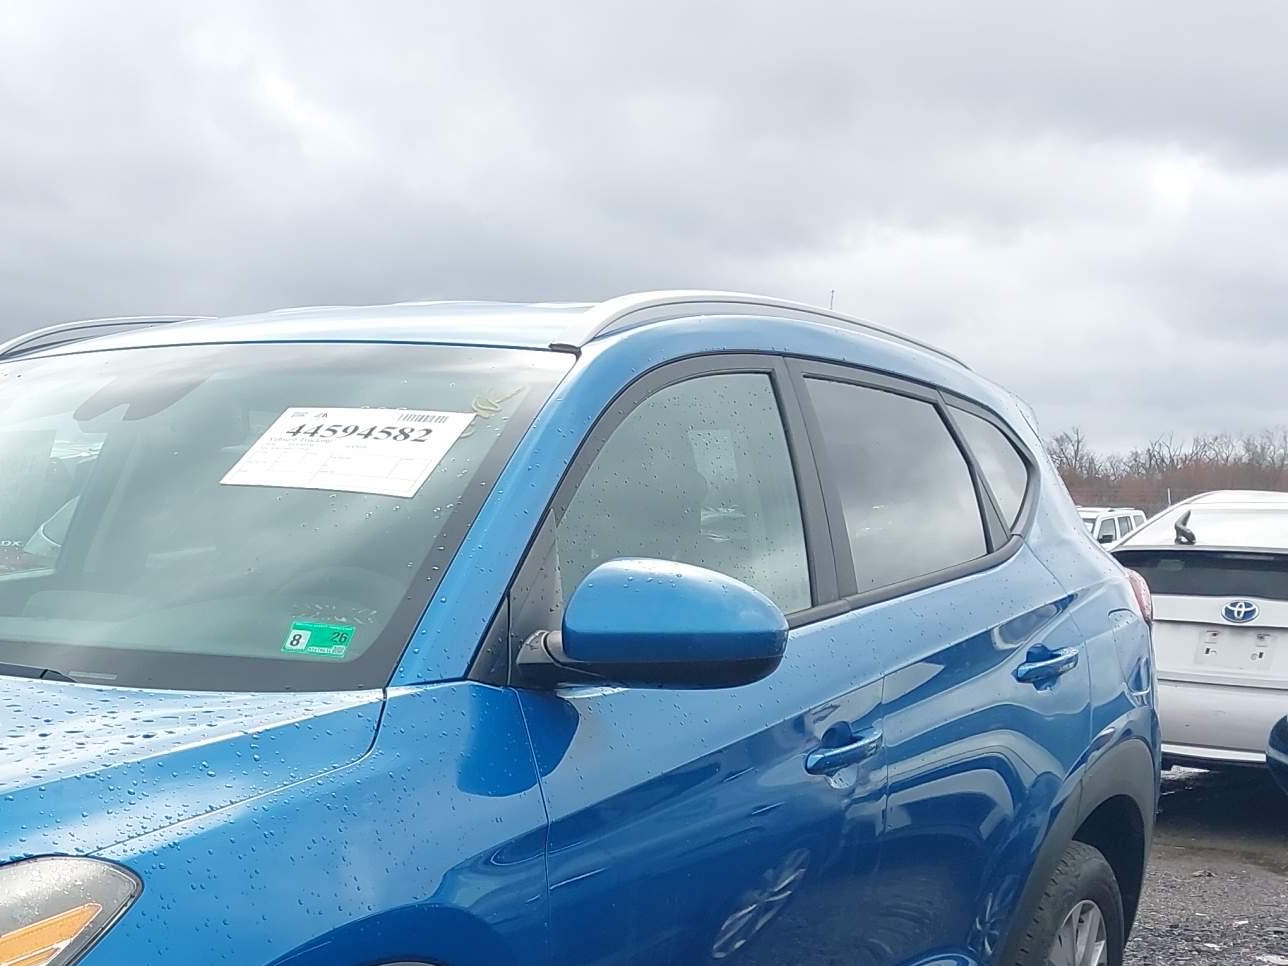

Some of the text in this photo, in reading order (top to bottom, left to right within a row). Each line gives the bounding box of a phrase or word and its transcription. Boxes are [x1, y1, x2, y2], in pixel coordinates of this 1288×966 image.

[285, 423, 434, 443] 44594582
[289, 631, 349, 647] 8 26
